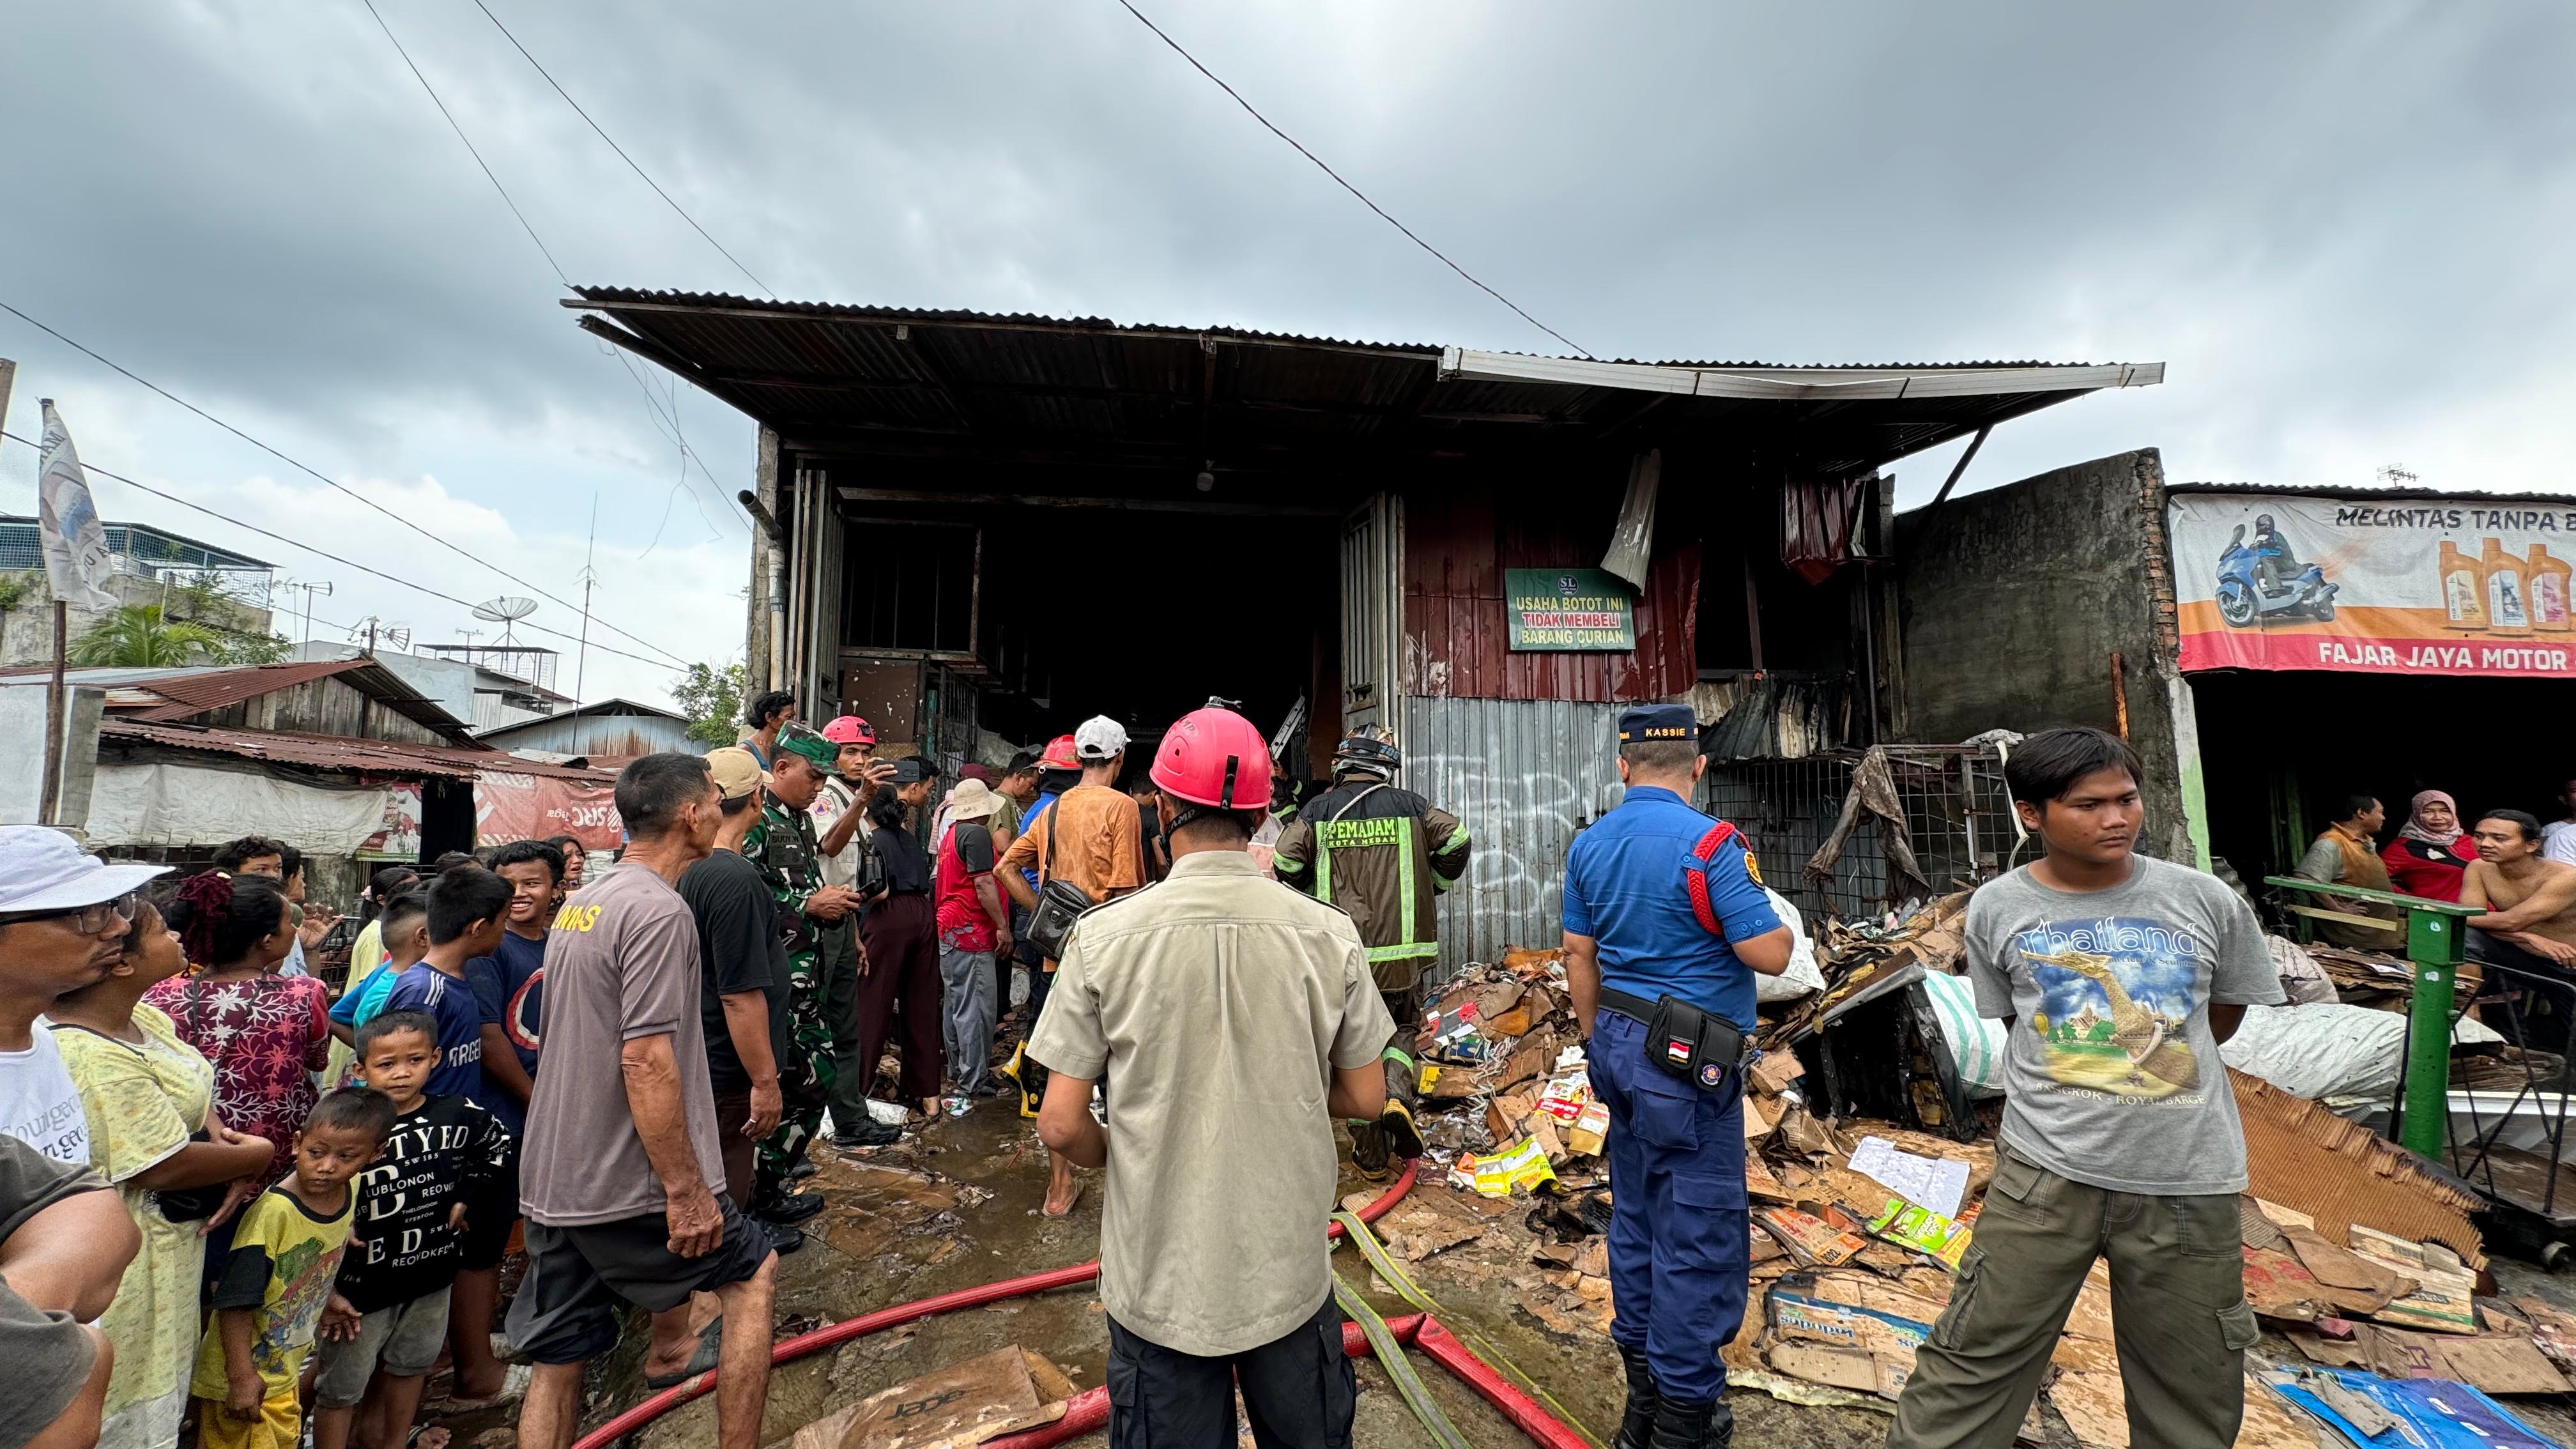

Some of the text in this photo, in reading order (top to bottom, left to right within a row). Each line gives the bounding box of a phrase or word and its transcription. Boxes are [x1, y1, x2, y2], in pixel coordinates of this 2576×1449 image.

[2471, 510, 2556, 531] TANPA
[1560, 578, 1576, 587] SL
[1516, 597, 1623, 611] USAHA BOTOT INI
[1522, 613, 1620, 627] TIDAK MEMBELI
[1521, 630, 1624, 644] BARANG CURIAN
[2318, 641, 2567, 671] FAJAR JAYA MOTOR
[1645, 728, 1685, 737] KASSIE
[571, 806, 607, 827] SRC
[1328, 818, 1396, 838] PEMADAM
[1361, 836, 1396, 845] MEDAN
[2009, 916, 2205, 958] Thailand
[2033, 1082, 2103, 1102] BANGKOK
[2116, 1094, 2163, 1105] ROYAL
[884, 1389, 968, 1421] acer
